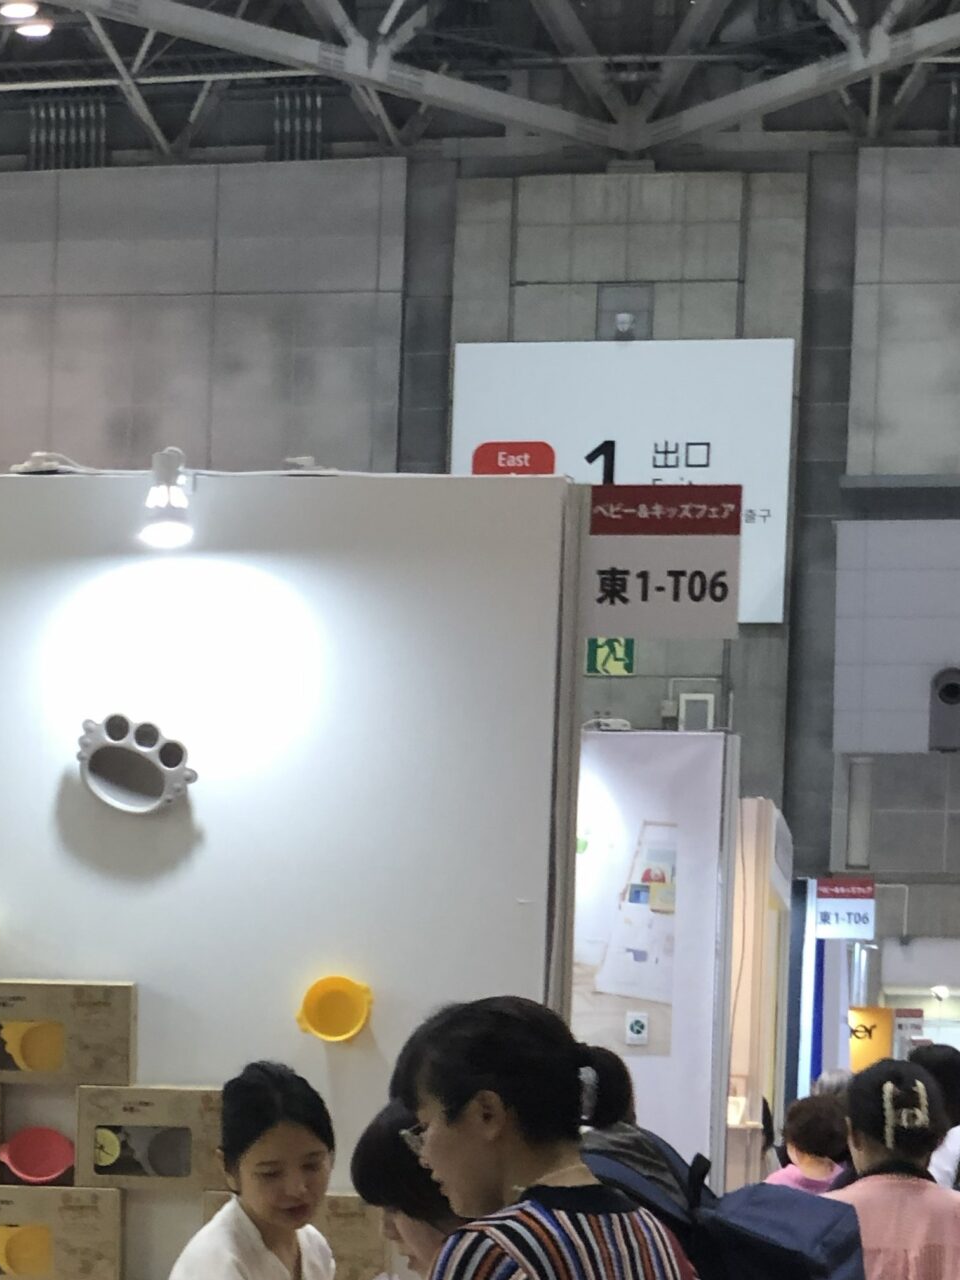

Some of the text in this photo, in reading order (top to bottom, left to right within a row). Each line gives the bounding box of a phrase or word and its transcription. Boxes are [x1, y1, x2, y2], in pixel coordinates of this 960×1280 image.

[497, 451, 530, 467] East
[584, 440, 616, 485] 1
[652, 440, 711, 468] 出口
[596, 566, 729, 606] 東1-T06
